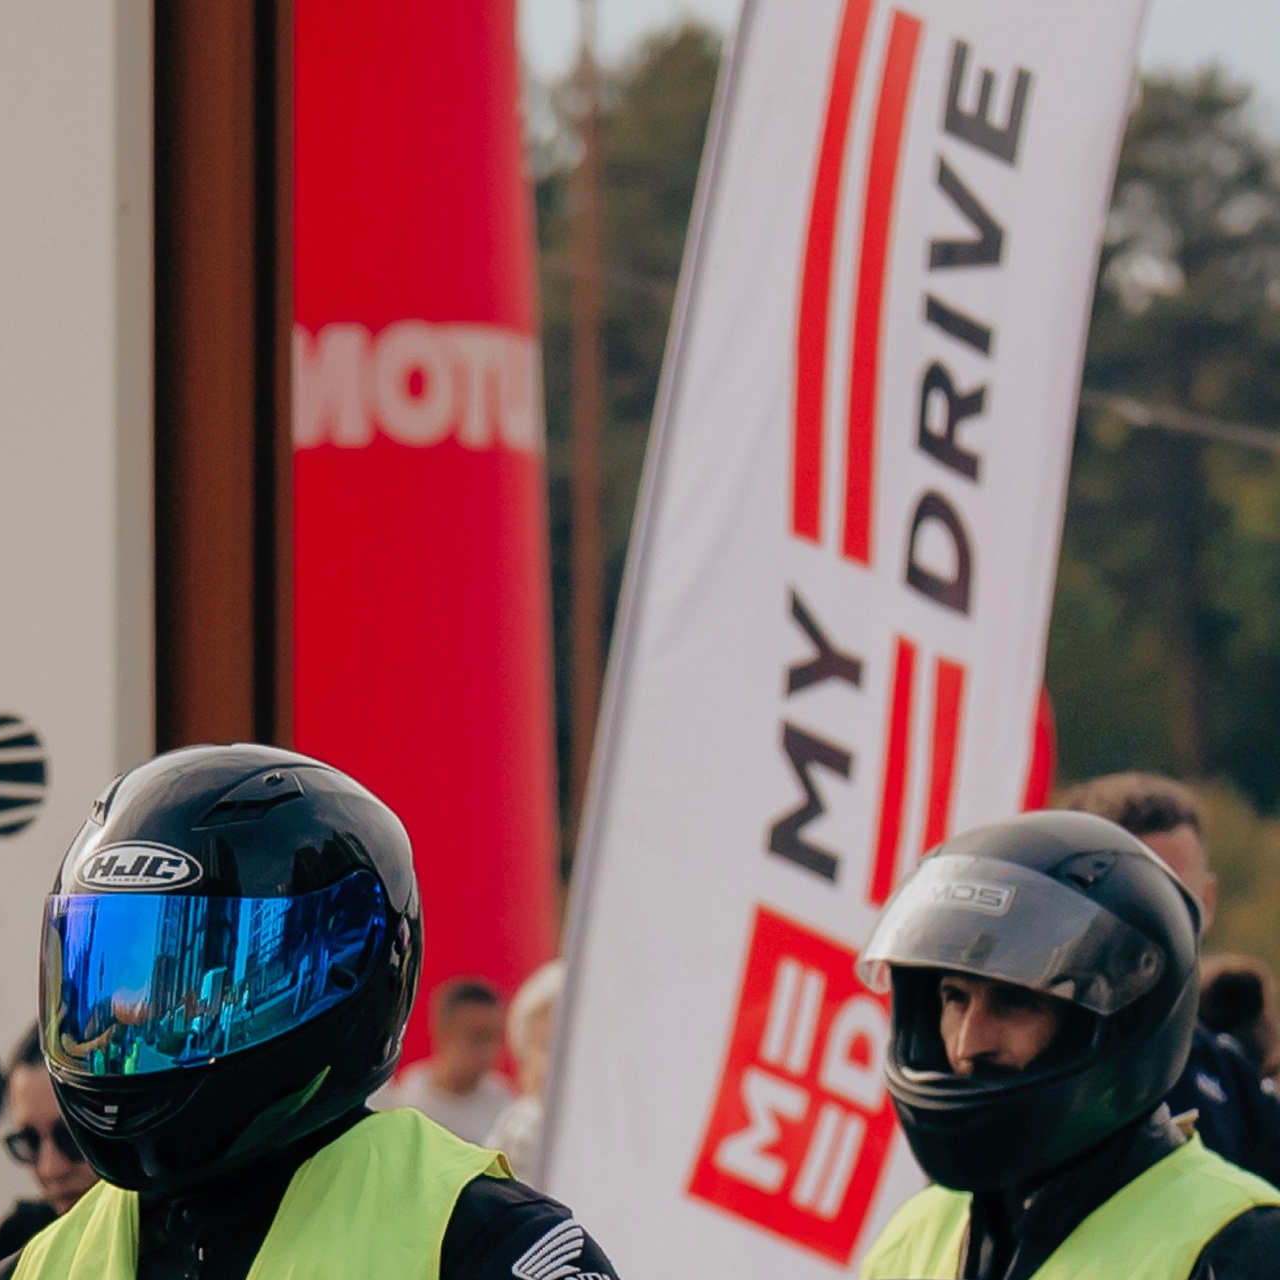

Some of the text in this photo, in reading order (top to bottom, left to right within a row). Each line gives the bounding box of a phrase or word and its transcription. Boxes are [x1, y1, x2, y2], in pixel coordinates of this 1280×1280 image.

[905, 39, 1033, 617] DRIVE
[87, 854, 184, 880] HJC
[766, 584, 866, 885] MY
